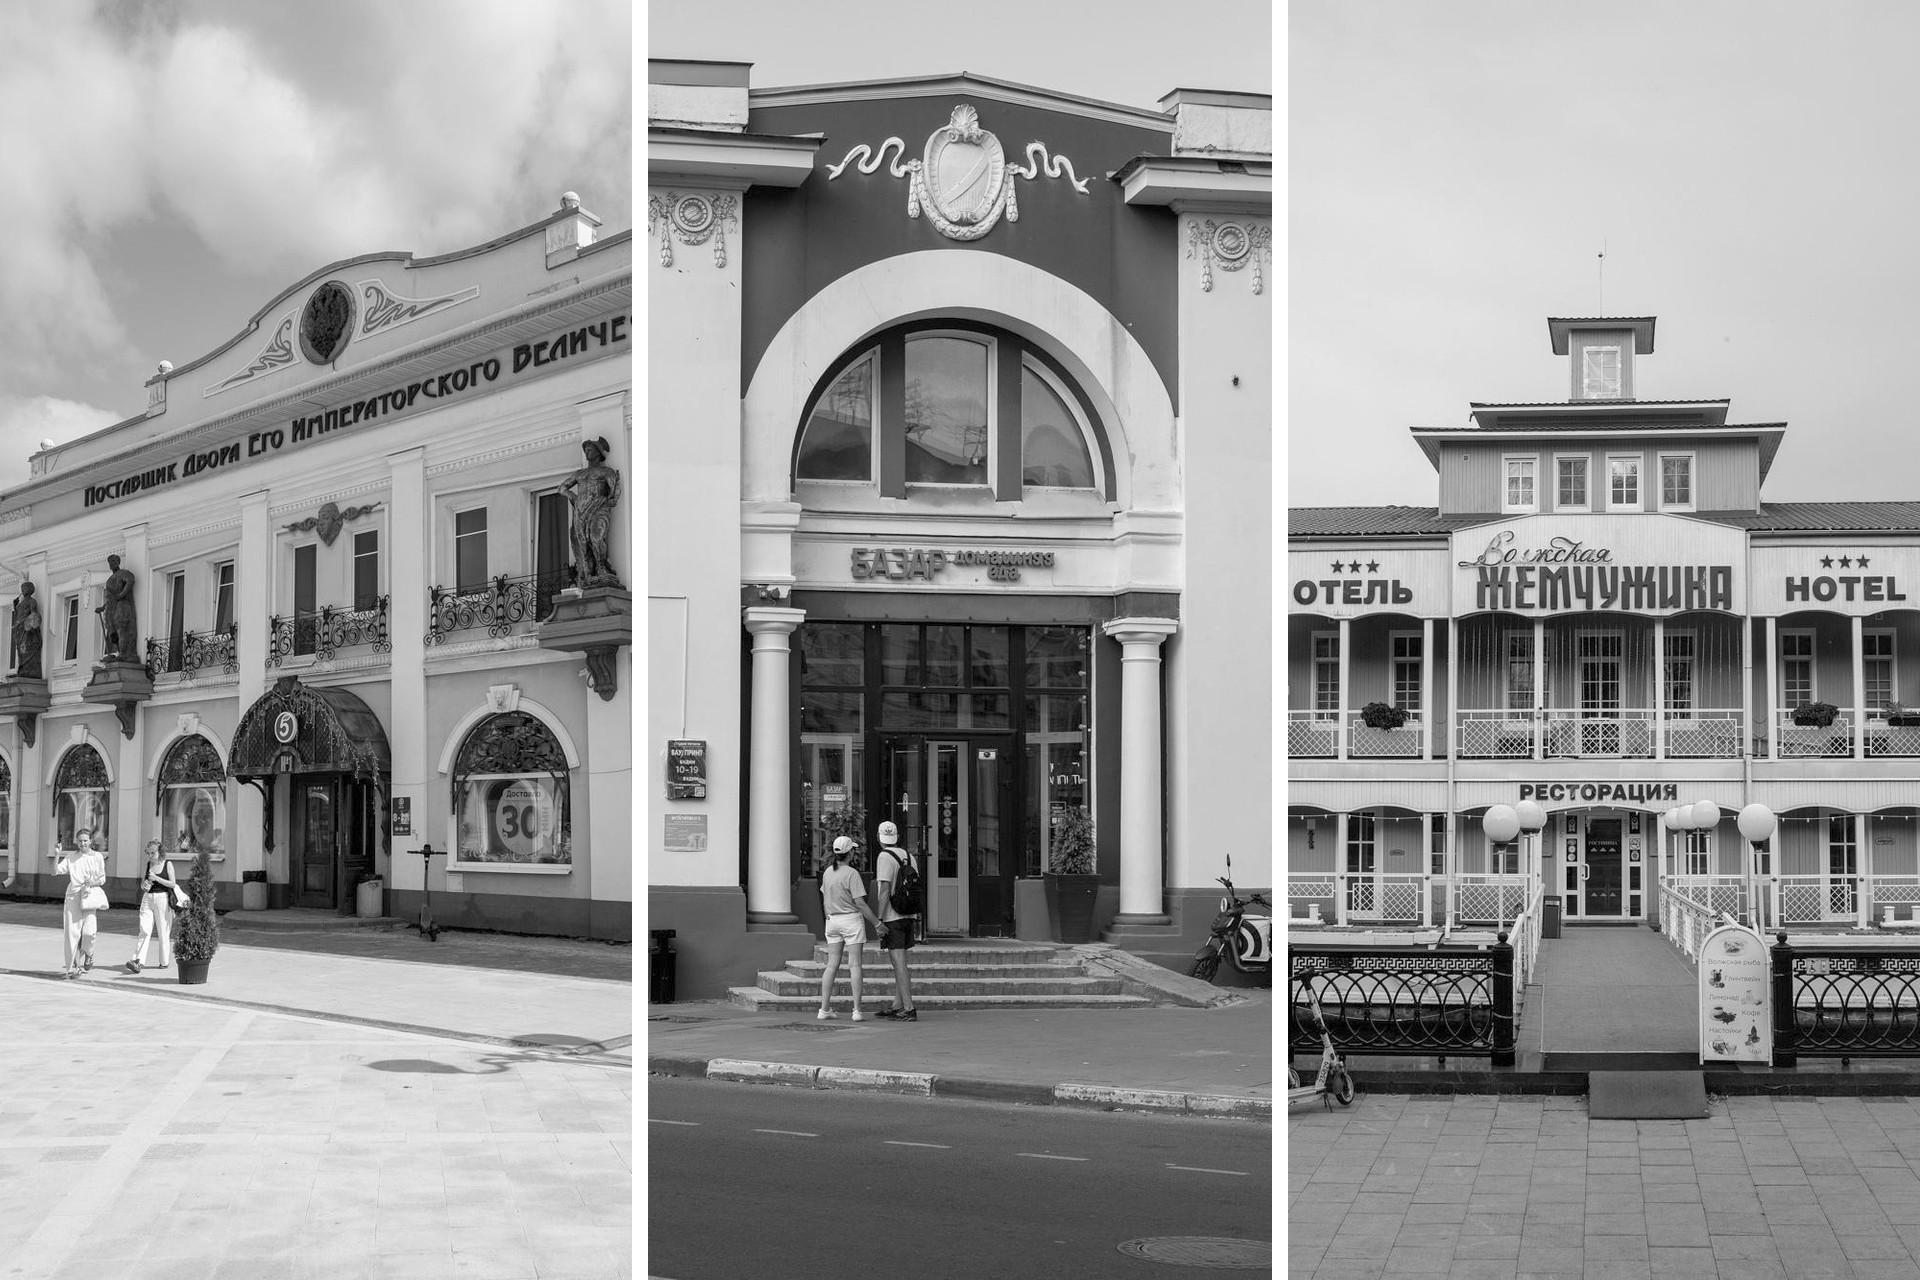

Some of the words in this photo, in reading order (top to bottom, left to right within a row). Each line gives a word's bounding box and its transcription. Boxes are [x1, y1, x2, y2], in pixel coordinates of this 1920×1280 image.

[513, 315, 632, 374] ВЕЛИЧЕ
[851, 547, 947, 580] БАЗАР
[1293, 579, 1413, 605] ОТЕЛЬ
[1477, 566, 1732, 610] ЖЕМЧУЖИНА
[1786, 576, 1906, 602] HOTEL
[675, 765, 699, 774] 10-19
[1520, 784, 1678, 804] РЕСТОРАЦИЯ
[502, 804, 541, 840] 30
